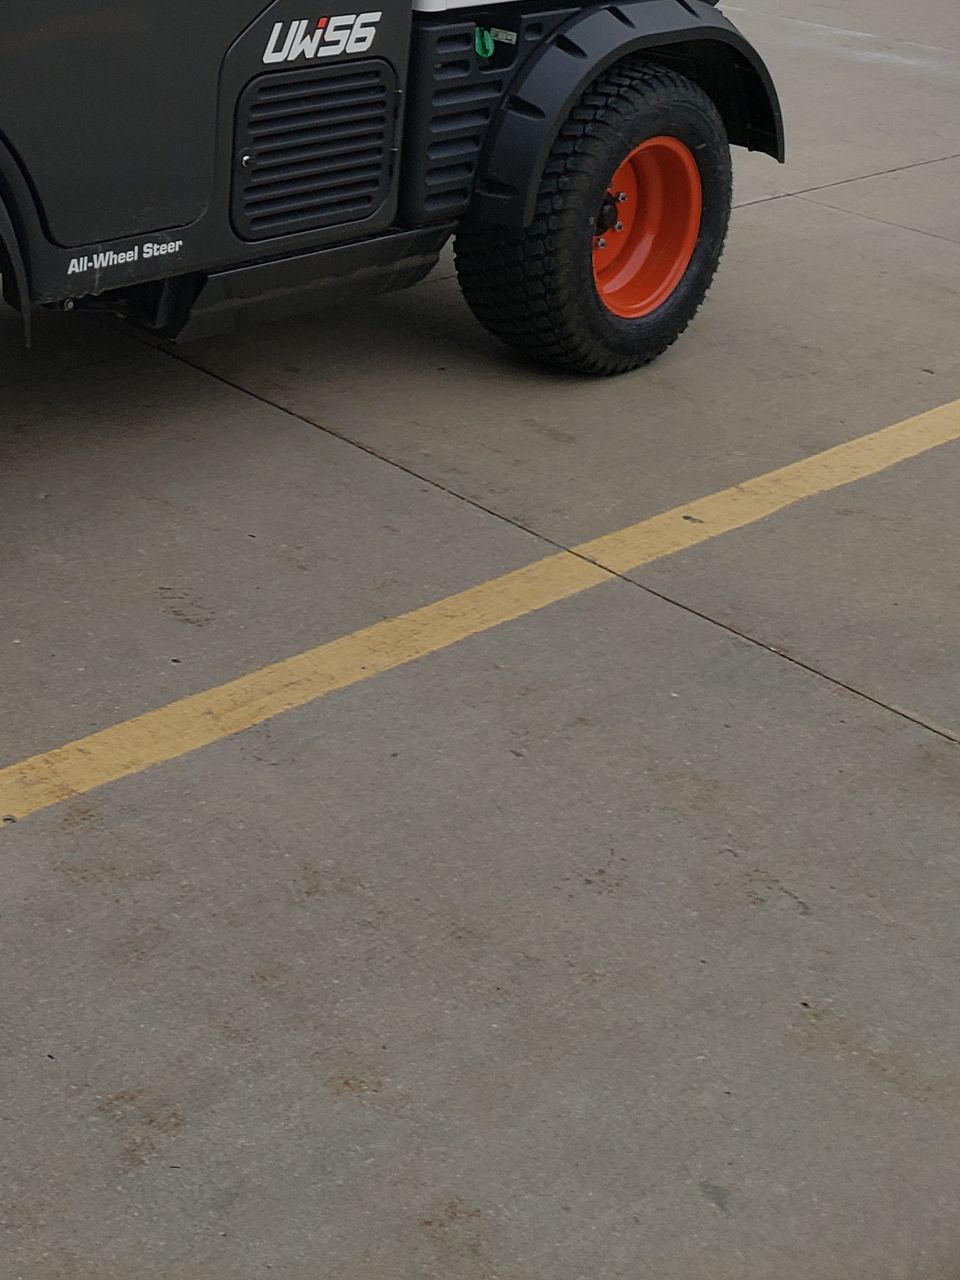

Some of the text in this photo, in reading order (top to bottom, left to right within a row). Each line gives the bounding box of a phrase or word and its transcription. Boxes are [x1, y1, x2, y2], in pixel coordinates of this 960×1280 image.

[262, 11, 383, 64] UW56
[67, 239, 183, 275] All-Wheel Steer
